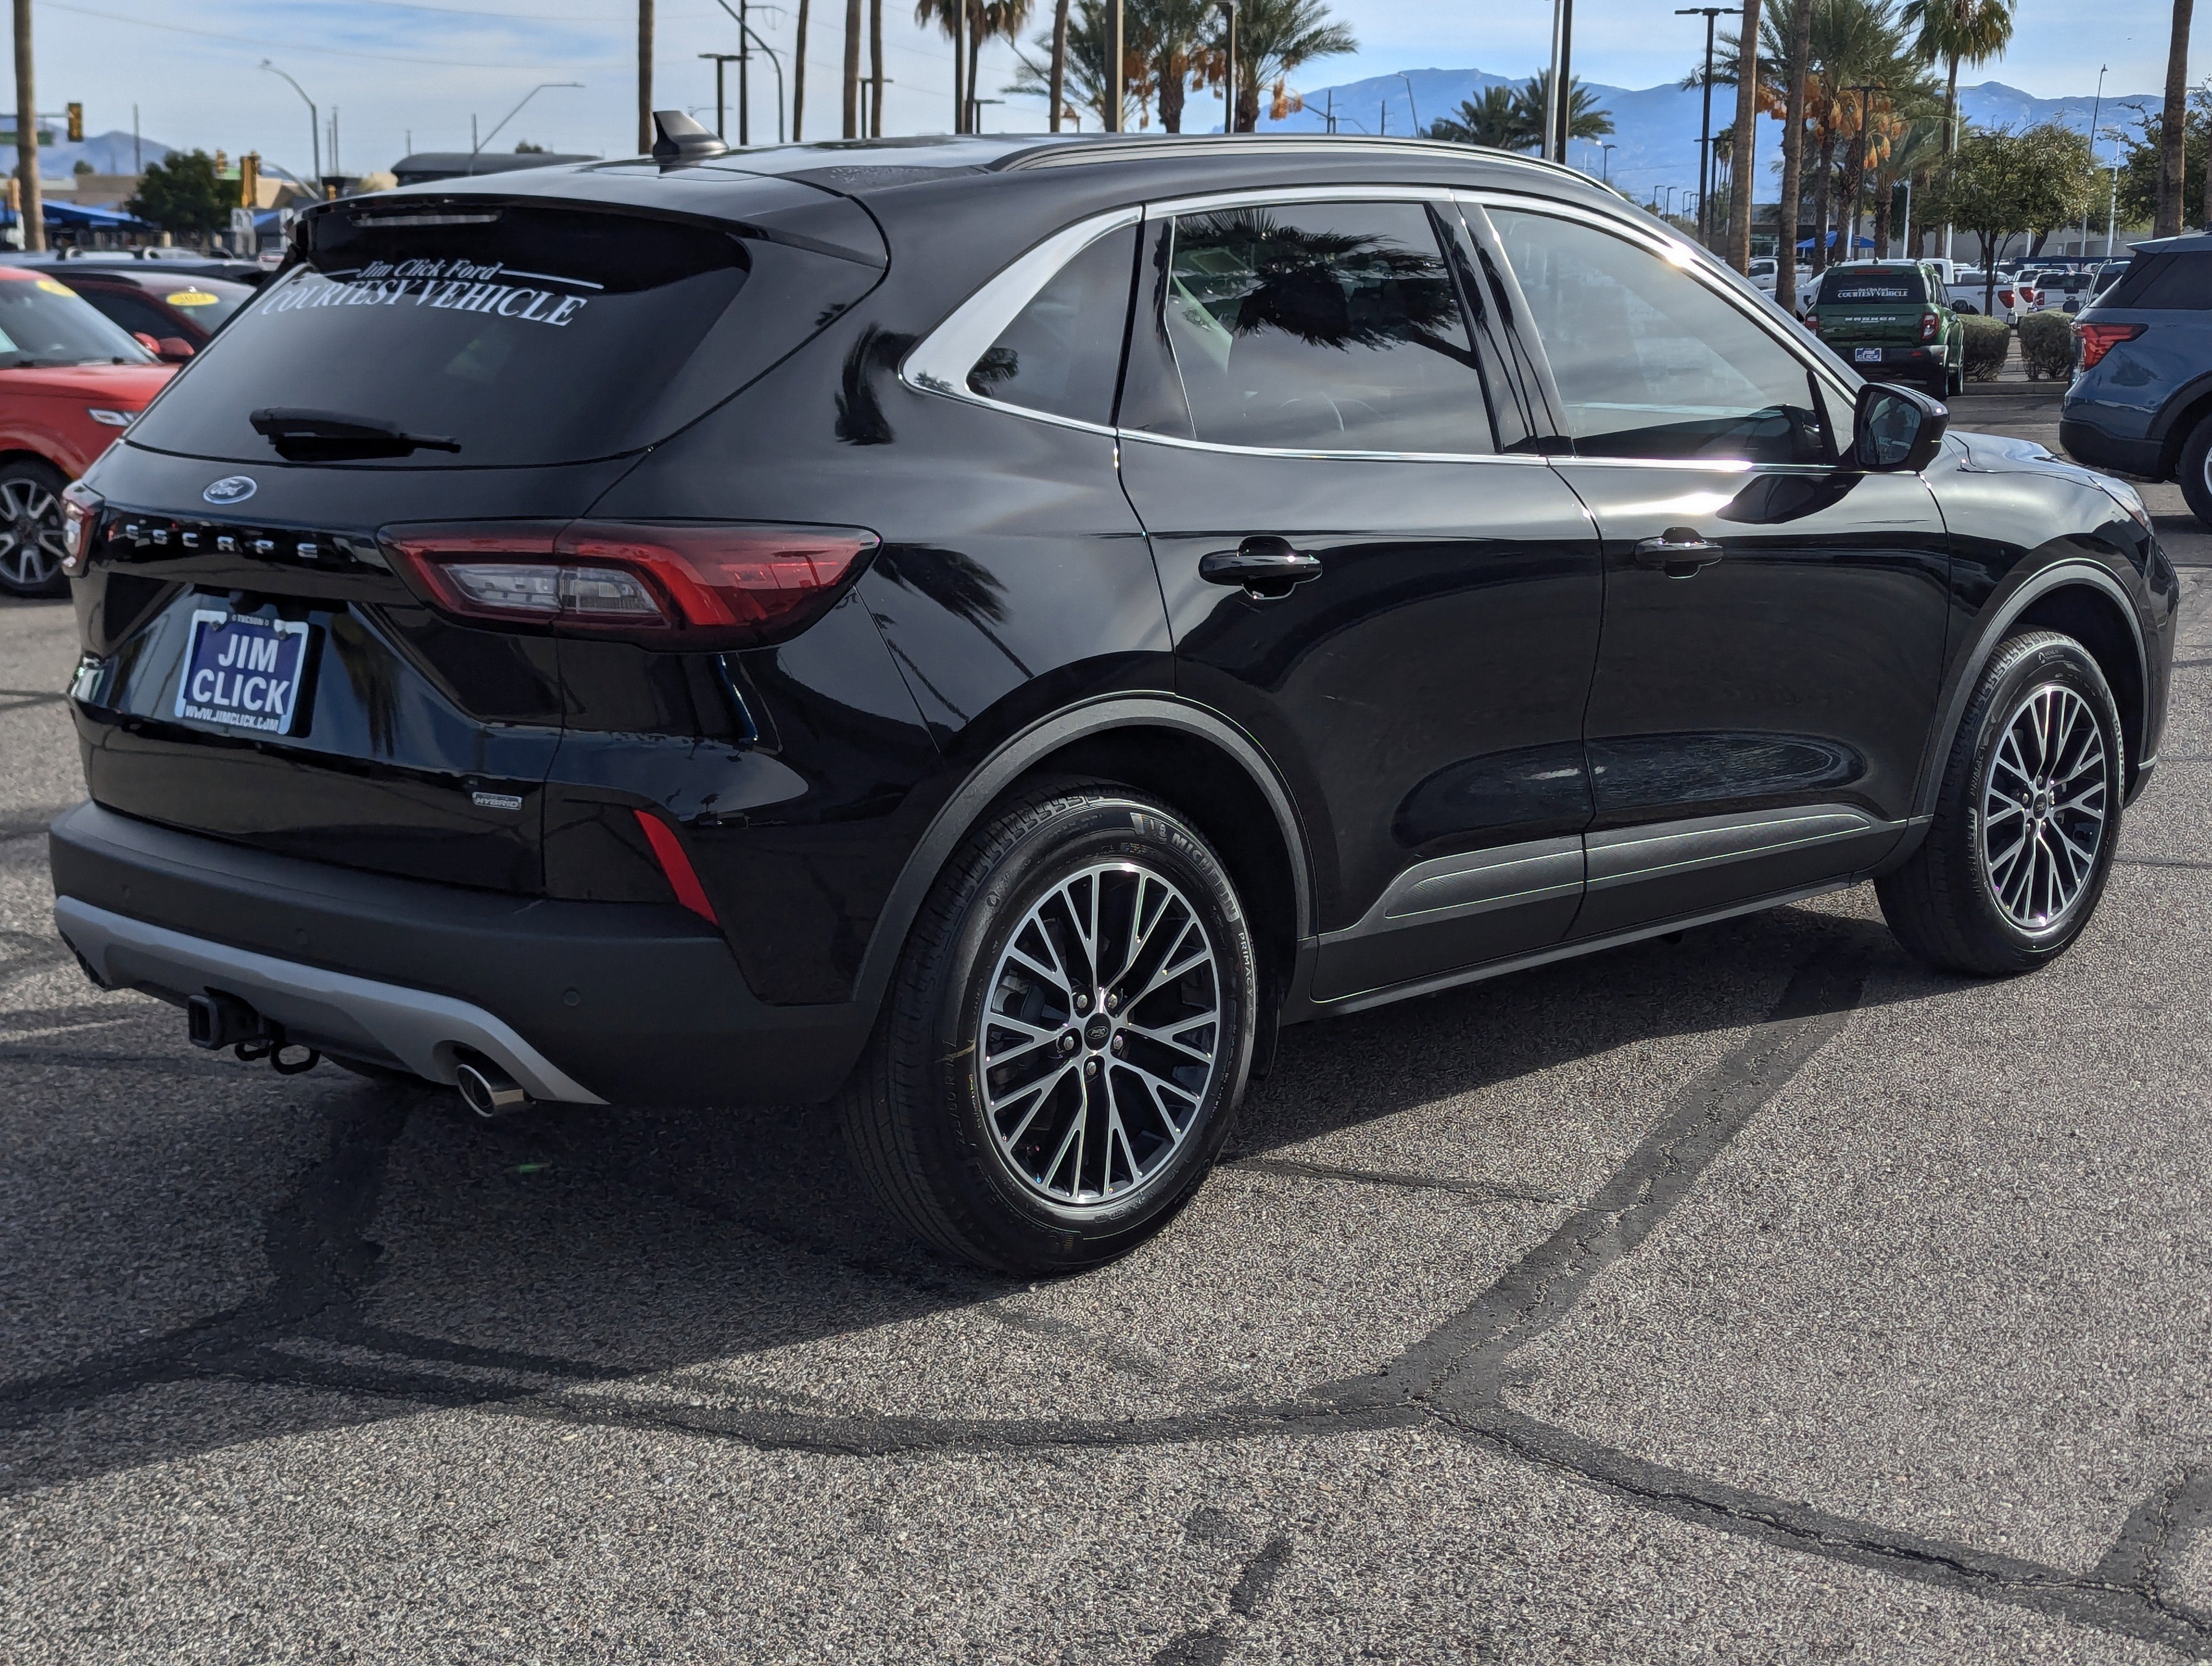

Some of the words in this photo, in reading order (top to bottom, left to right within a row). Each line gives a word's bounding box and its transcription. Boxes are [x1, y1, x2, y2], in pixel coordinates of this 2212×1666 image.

[356, 260, 394, 277] Jim
[394, 258, 447, 277] Click
[442, 258, 504, 280] Ford
[261, 279, 423, 316] COURTESY
[415, 280, 588, 326] VEHICLE
[125, 524, 318, 559] ESCAPE
[218, 633, 279, 673] JIM
[192, 669, 290, 715] CLICK
[475, 797, 519, 808] HYBRID
[1238, 932, 1253, 997] PRIMACY
